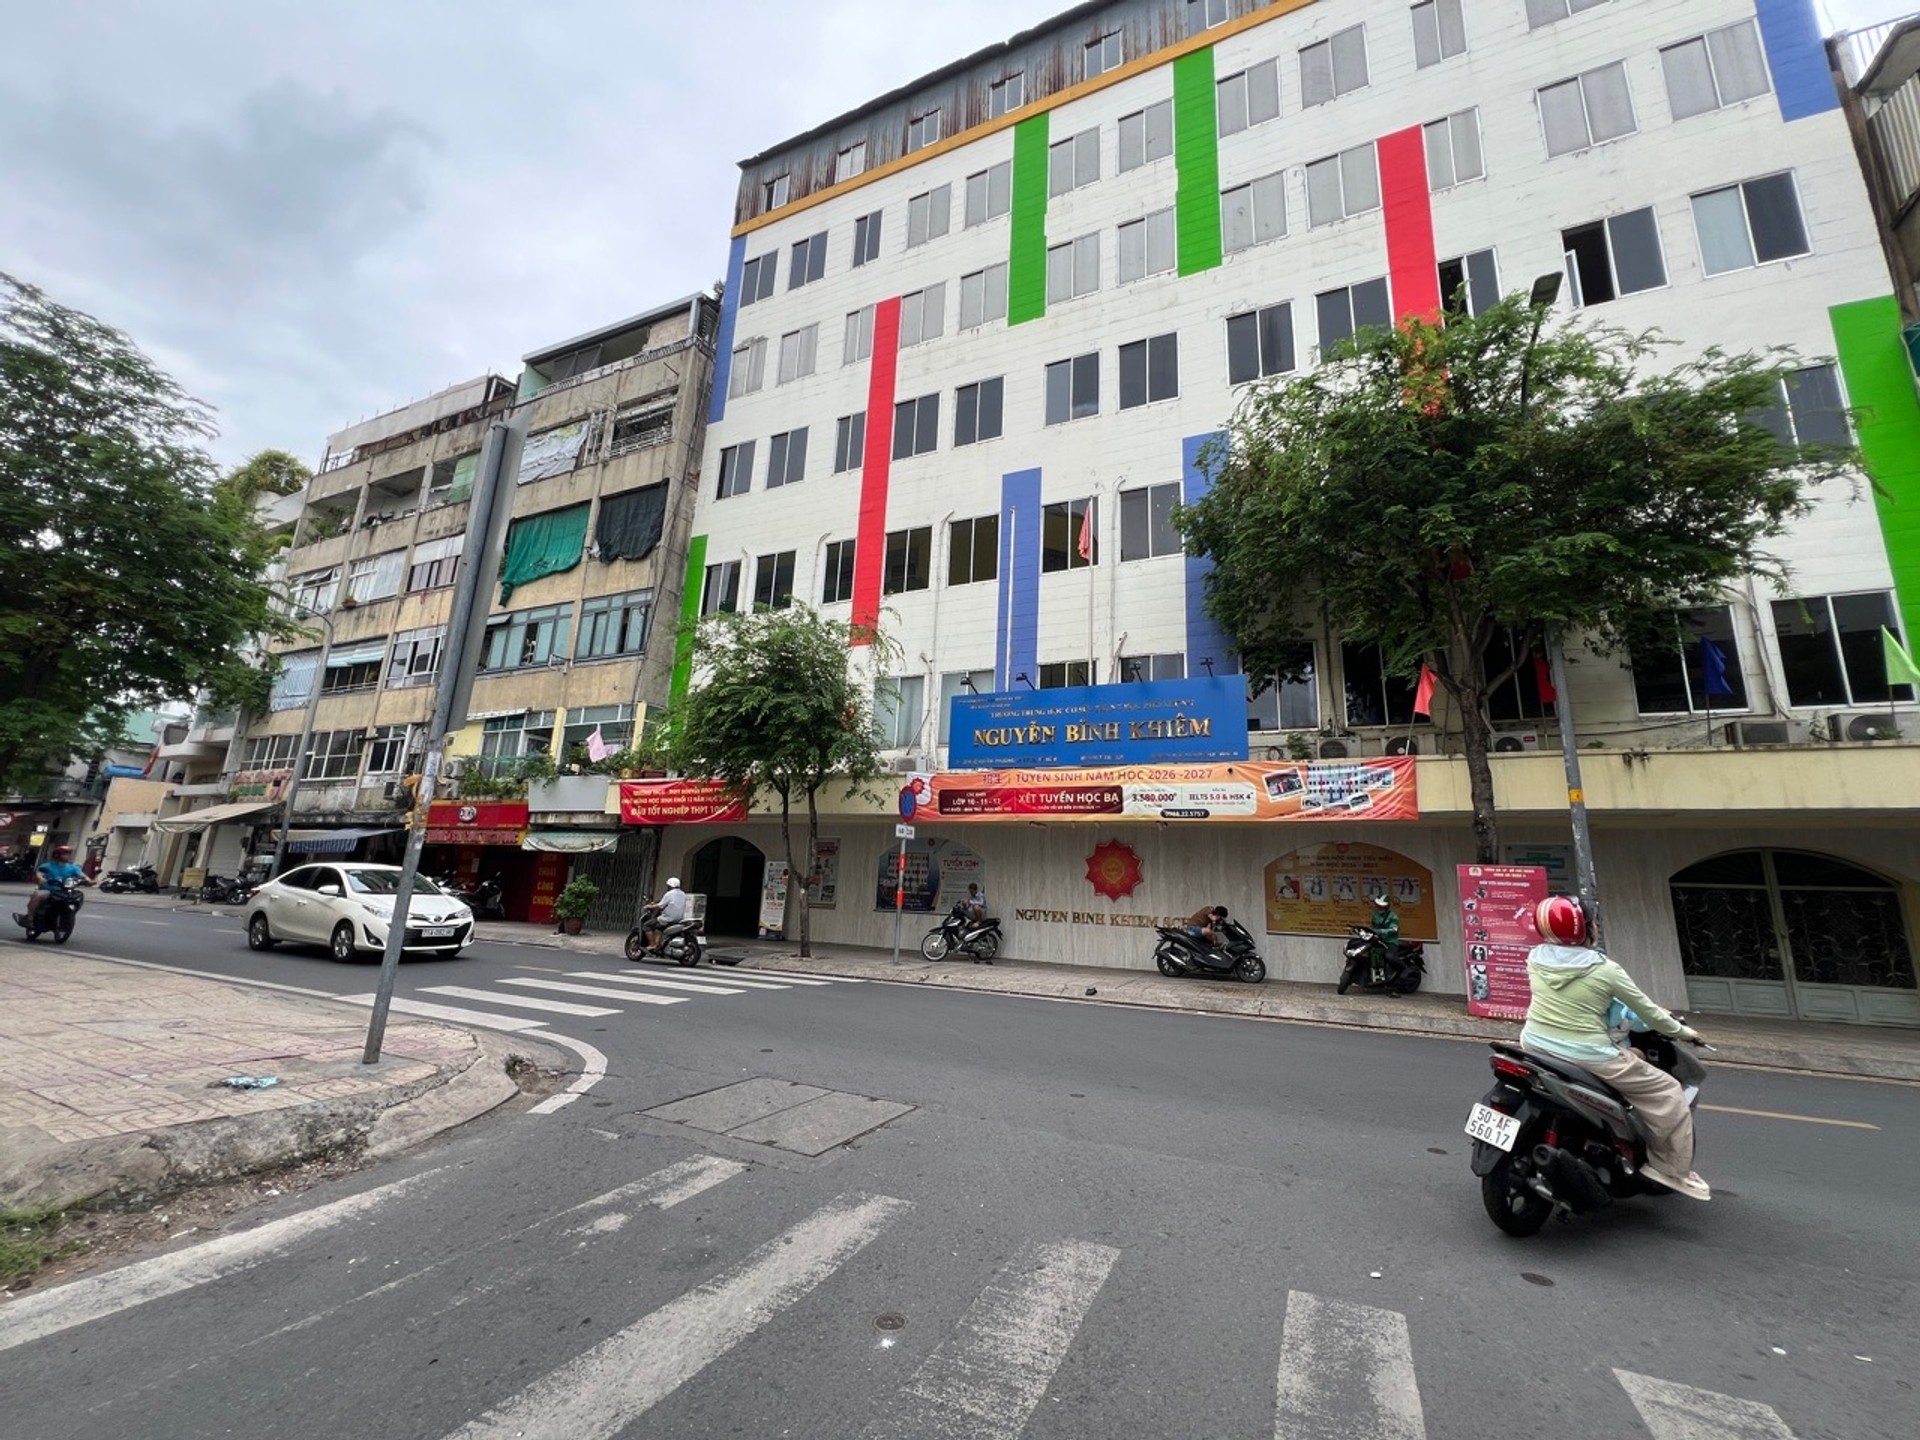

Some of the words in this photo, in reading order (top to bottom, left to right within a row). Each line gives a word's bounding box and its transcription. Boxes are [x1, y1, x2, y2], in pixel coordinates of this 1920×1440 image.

[974, 720, 1056, 746] NGUYỄN
[1128, 712, 1212, 740] KHIÊM
[1053, 772, 1082, 782] SINH
[1148, 770, 1176, 780] 2026
[1018, 792, 1036, 804] XÉT
[1076, 793, 1100, 805] HỌC
[1104, 792, 1120, 805] BẠ
[1189, 793, 1208, 801] IELTS
[1210, 793, 1220, 801] 5.0
[690, 806, 708, 814] THPT
[1015, 909, 1068, 922] NGUYEN
[1072, 912, 1106, 925] BINH
[1478, 1108, 1512, 1131] 50-AF
[1470, 1120, 1510, 1146] 560.17
